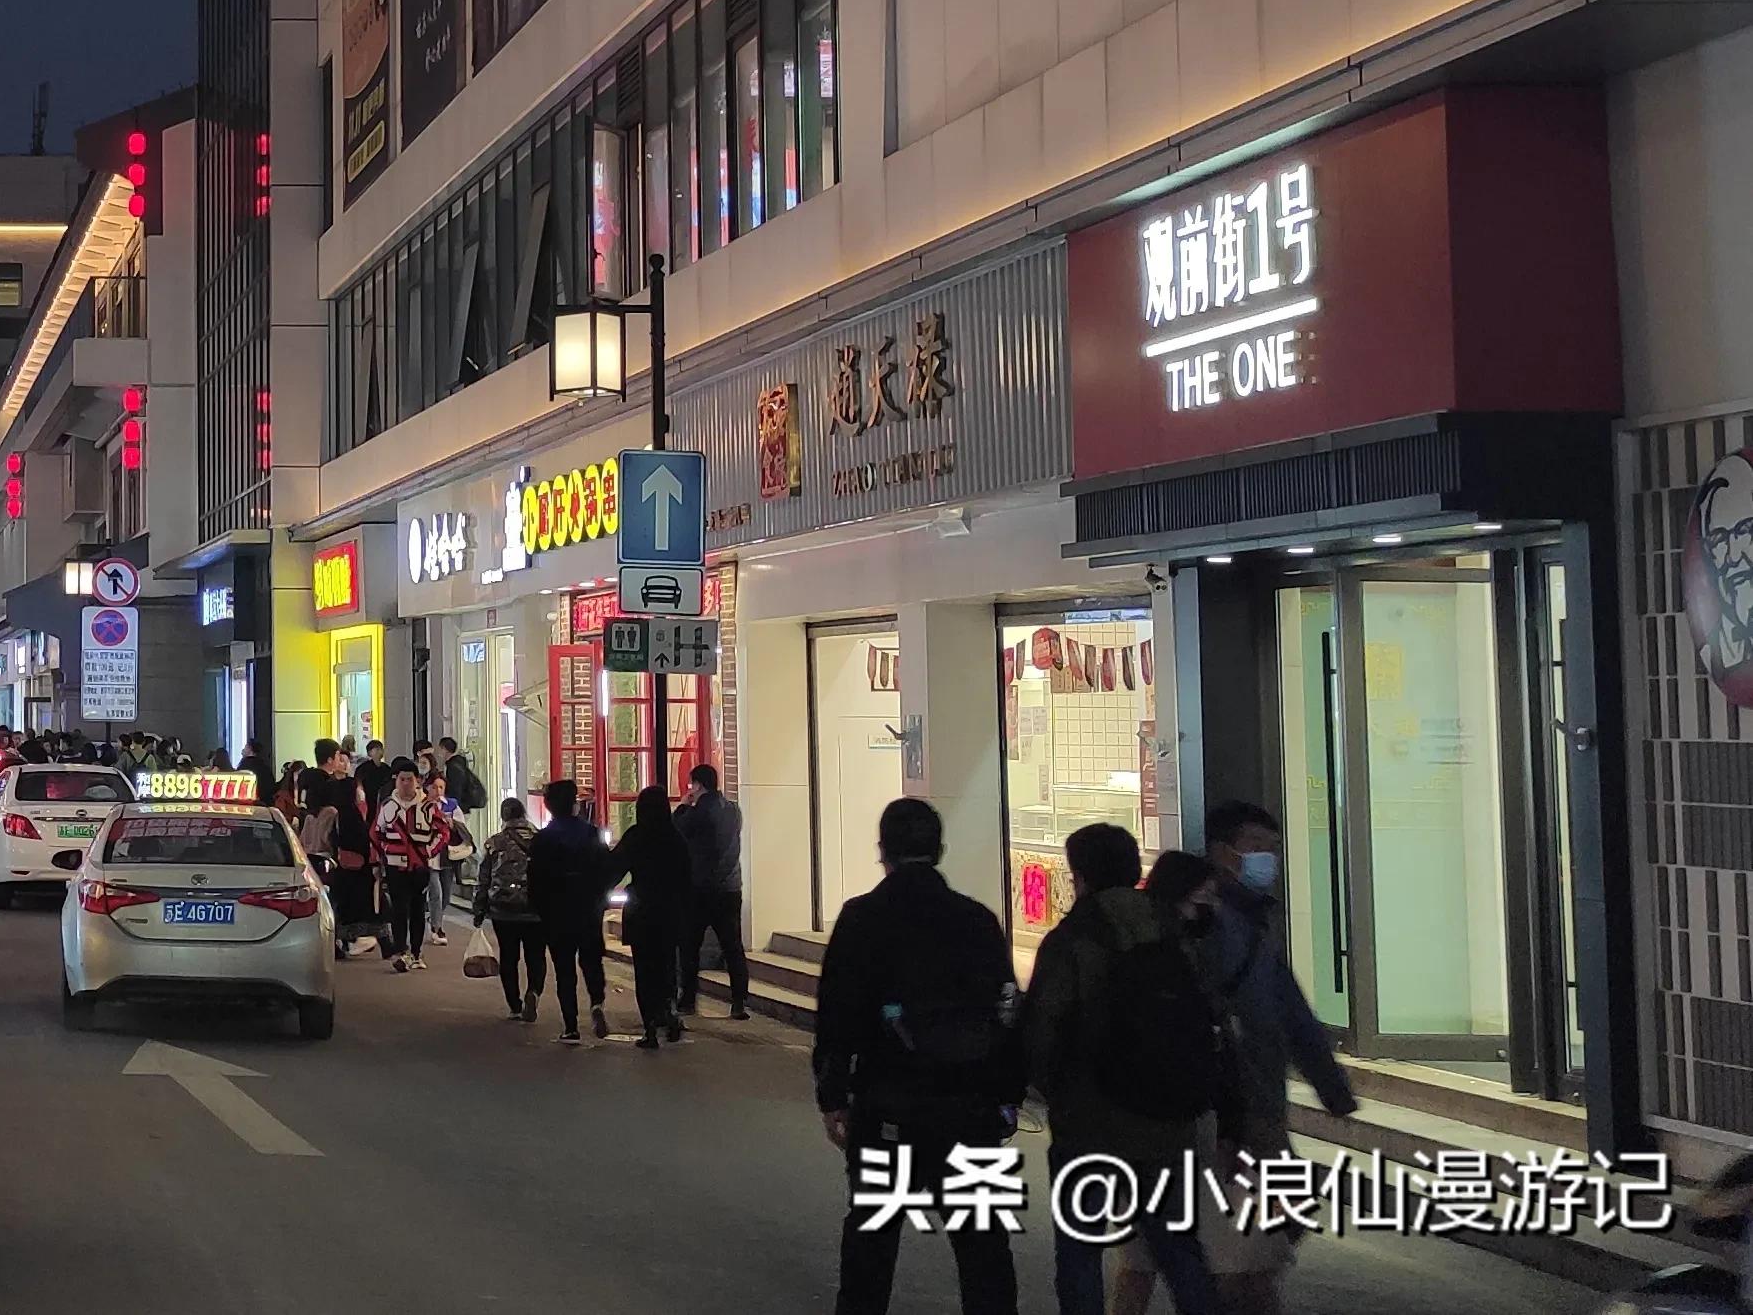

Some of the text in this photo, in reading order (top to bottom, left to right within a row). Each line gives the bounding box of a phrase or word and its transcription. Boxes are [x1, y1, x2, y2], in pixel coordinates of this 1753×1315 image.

[1142, 164, 1313, 328] 观前街1号
[1166, 331, 1297, 412] THE ONE
[150, 772, 257, 800] 88967777
